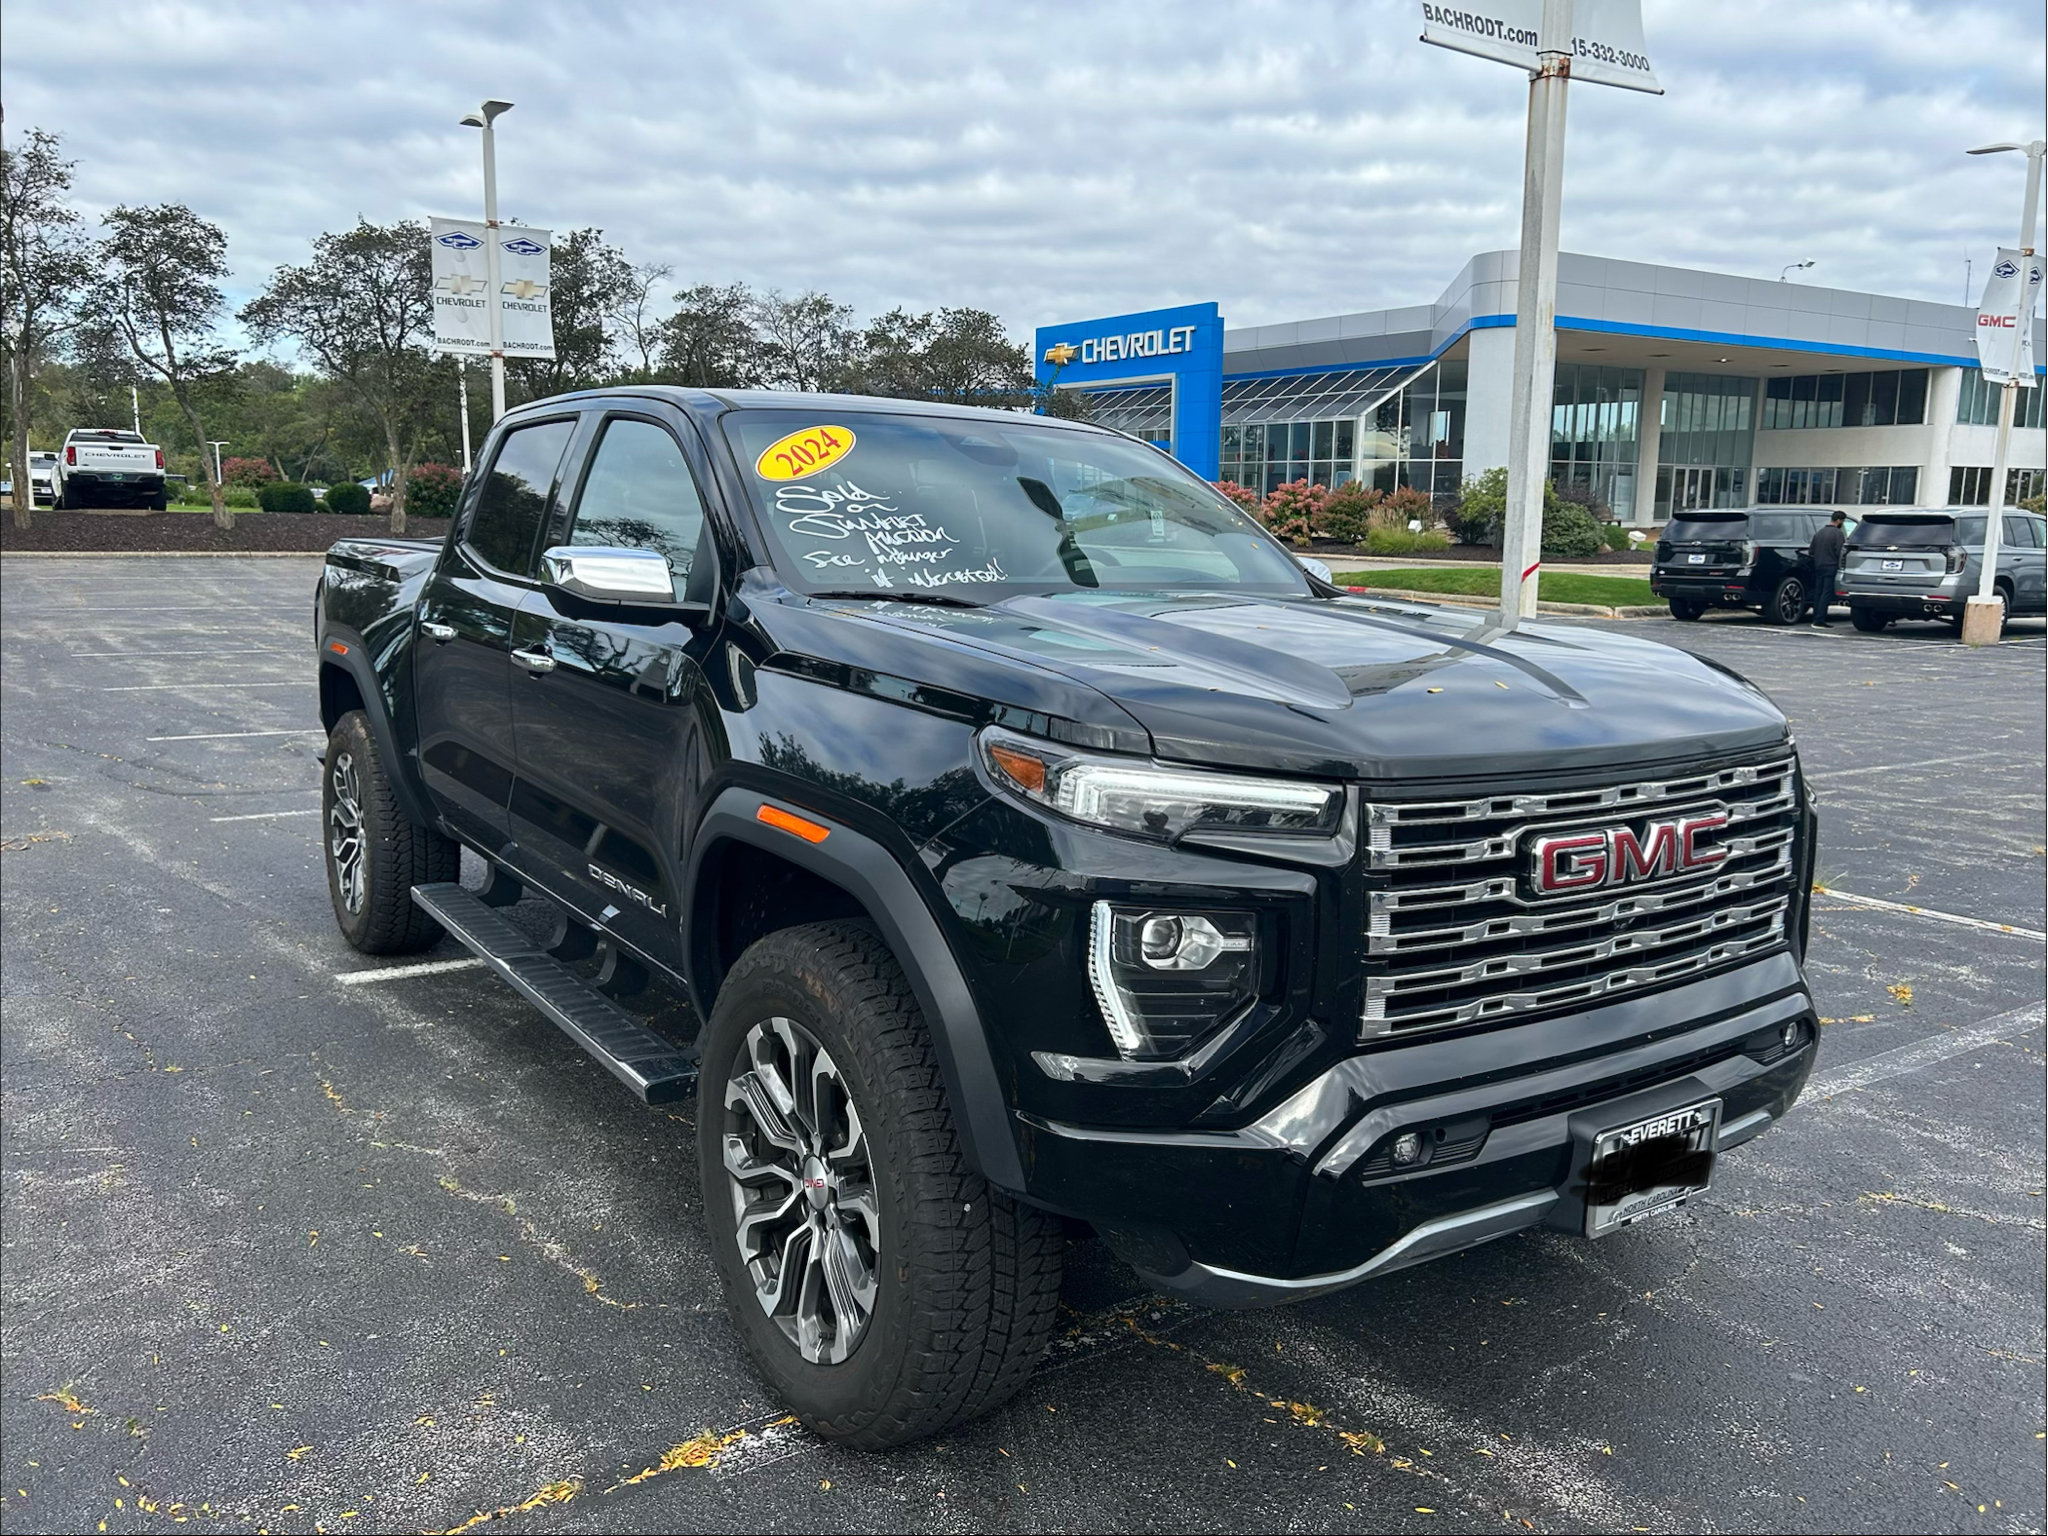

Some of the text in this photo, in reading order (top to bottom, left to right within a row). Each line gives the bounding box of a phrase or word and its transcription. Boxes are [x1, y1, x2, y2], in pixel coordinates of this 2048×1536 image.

[1422, 3, 1538, 46] BACHRODT.com
[1571, 37, 1650, 71] 15-332-3000
[436, 296, 486, 308] CHEVROLET
[502, 301, 548, 313] CHEVROLET
[1977, 313, 2016, 328] GMC
[1081, 325, 1197, 364] CHEVROLET
[84, 451, 148, 459] CHEVROLET
[775, 429, 841, 476] 2024
[776, 480, 891, 514] Sold
[802, 550, 866, 569] See
[1532, 812, 1728, 895] GMC
[588, 863, 667, 918] DENALI
[1631, 1110, 1695, 1144] EVERETT
